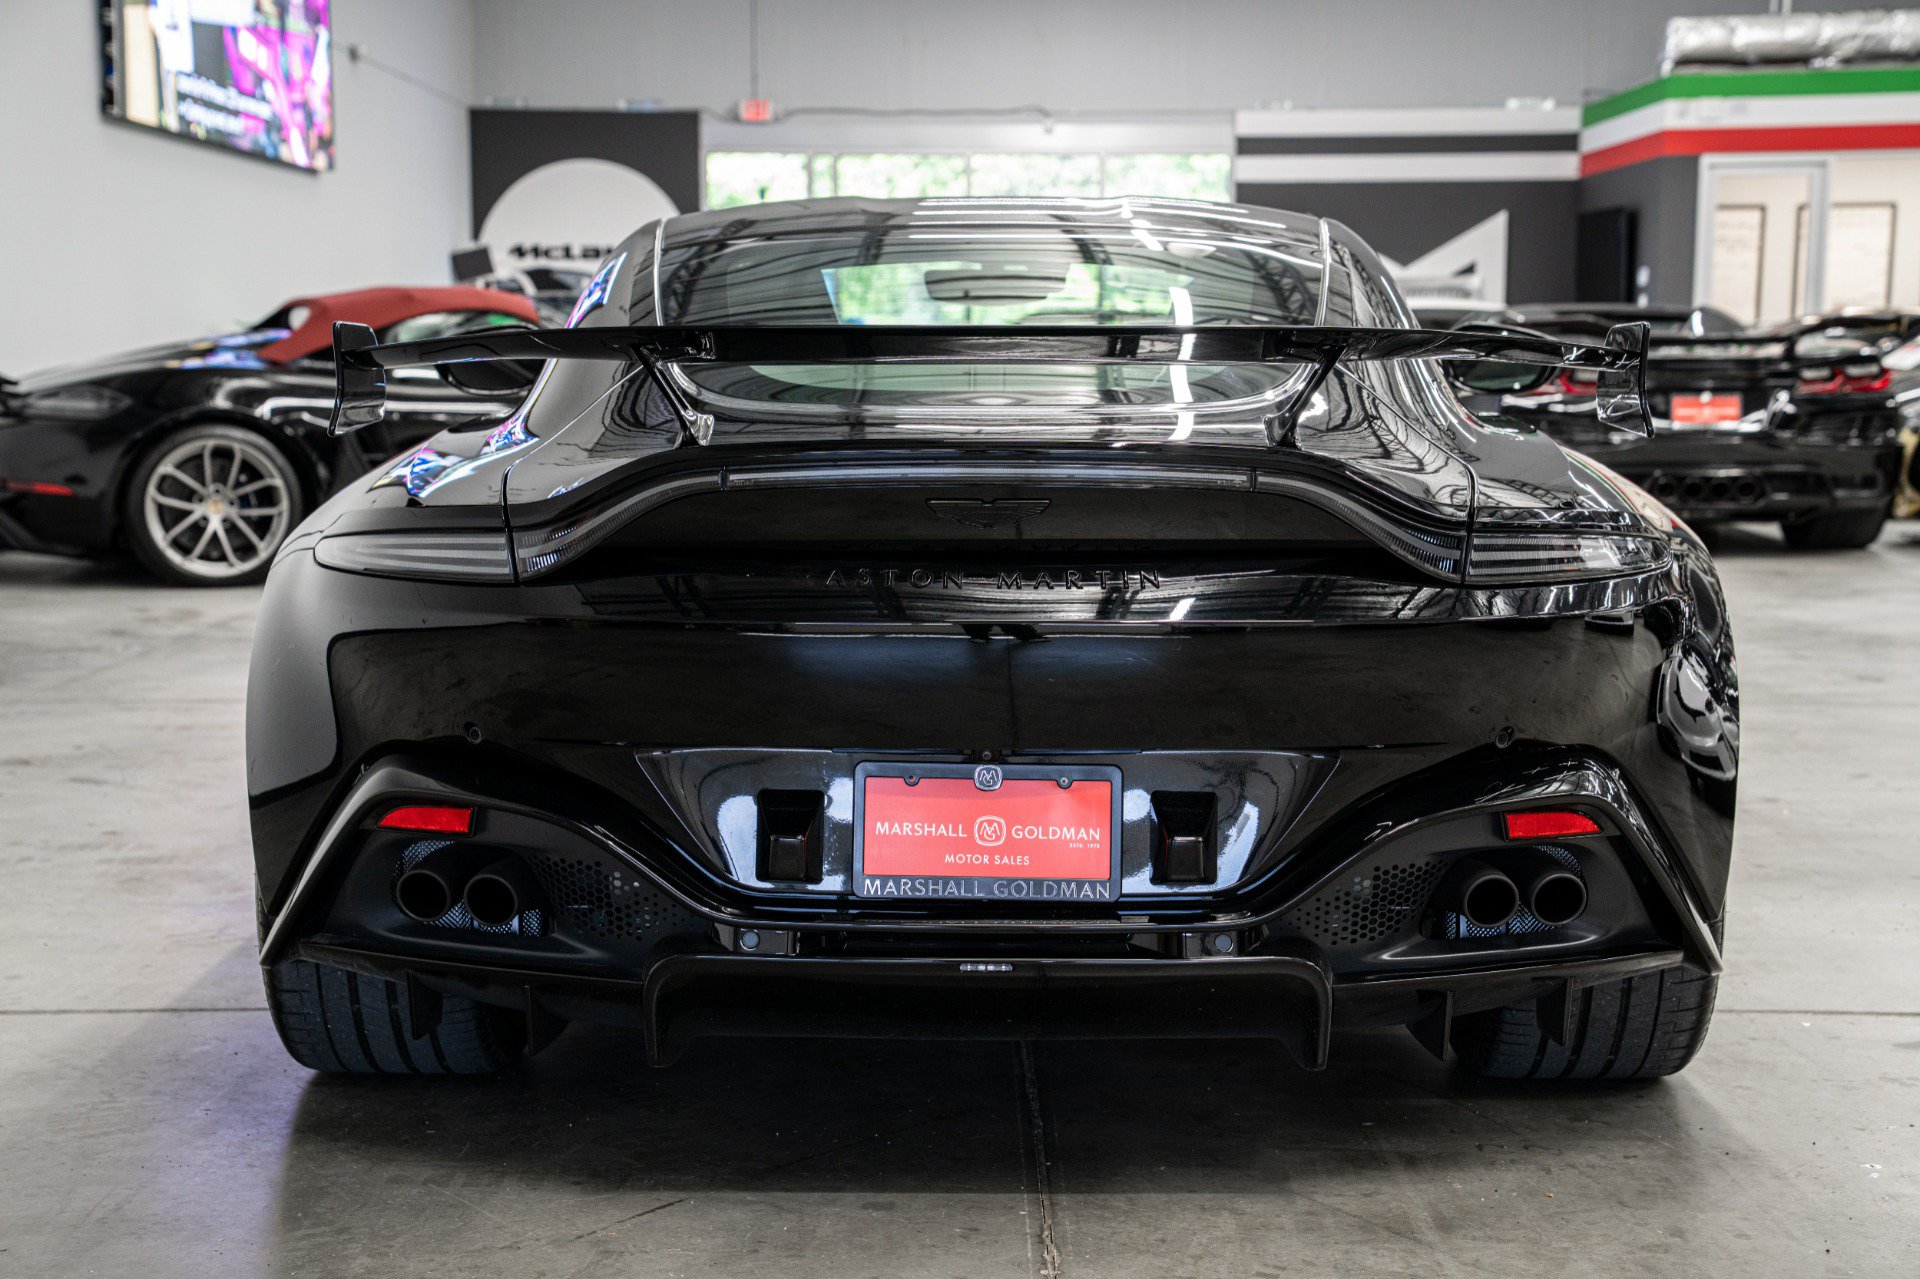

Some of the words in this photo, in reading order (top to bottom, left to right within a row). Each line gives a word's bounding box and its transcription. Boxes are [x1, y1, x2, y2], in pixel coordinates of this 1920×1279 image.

[825, 568, 964, 590] ASTON
[997, 569, 1162, 591] MARTIN
[875, 821, 968, 838] MARSHALL
[1011, 825, 1101, 841] GOLDMAN
[944, 853, 990, 865] MOTOR
[994, 855, 1031, 866] SALES
[863, 878, 986, 897] MARSHALL
[993, 880, 1110, 899] GOLDMAN
